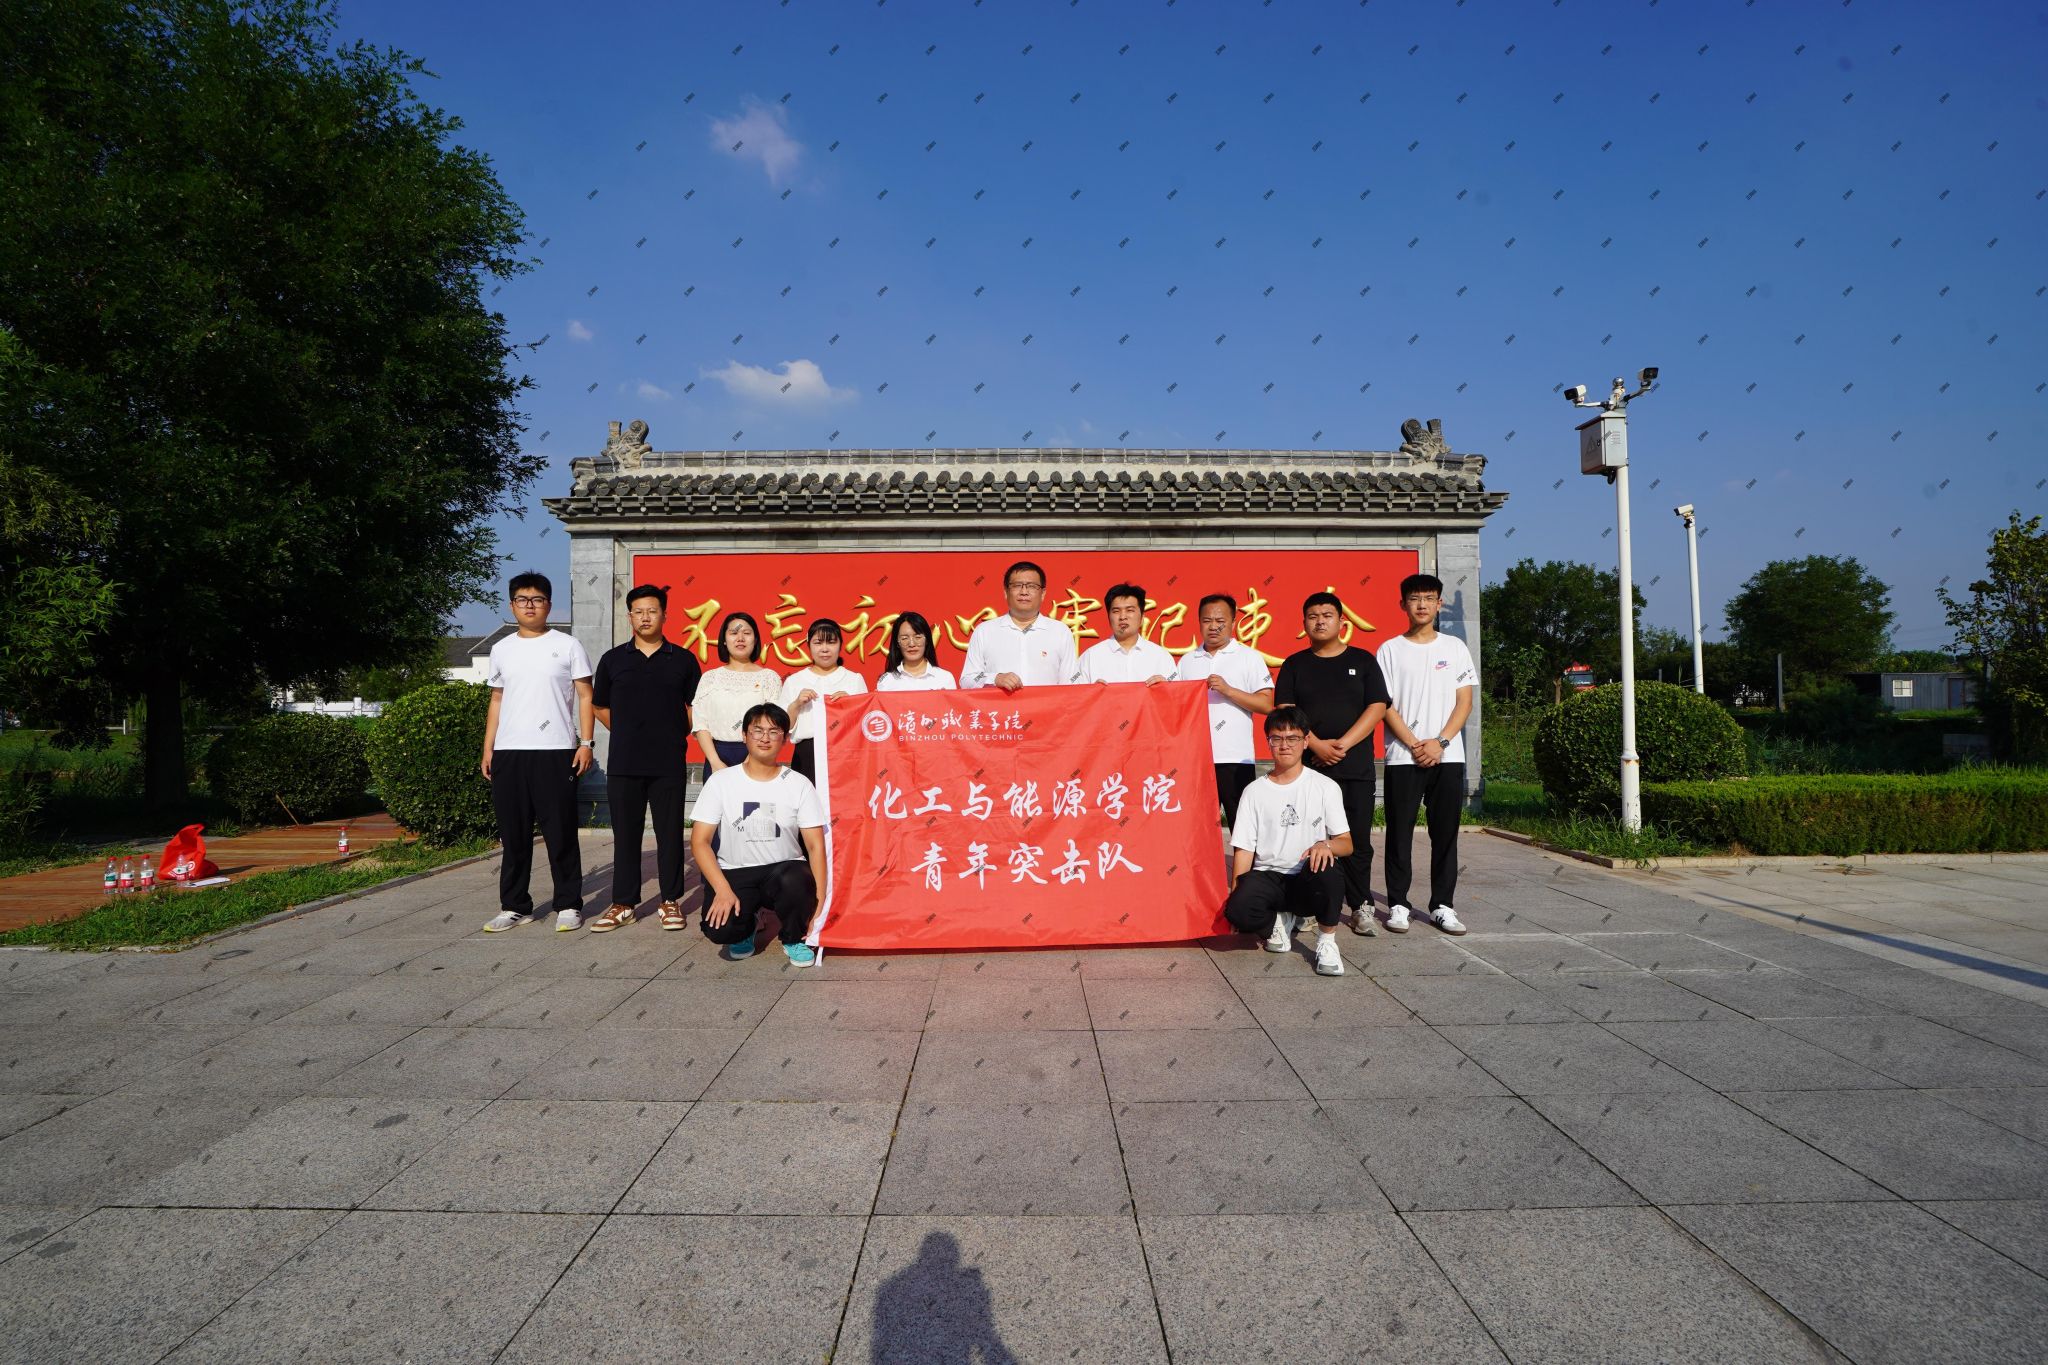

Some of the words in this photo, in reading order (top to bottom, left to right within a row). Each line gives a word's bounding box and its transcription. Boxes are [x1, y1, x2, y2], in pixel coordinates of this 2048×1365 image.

[898, 734, 945, 742] BINZHOU
[951, 733, 1024, 741] POLYTECHNIC
[868, 772, 1182, 821] 化工与能源学院
[910, 839, 1143, 892] 青年突击队
